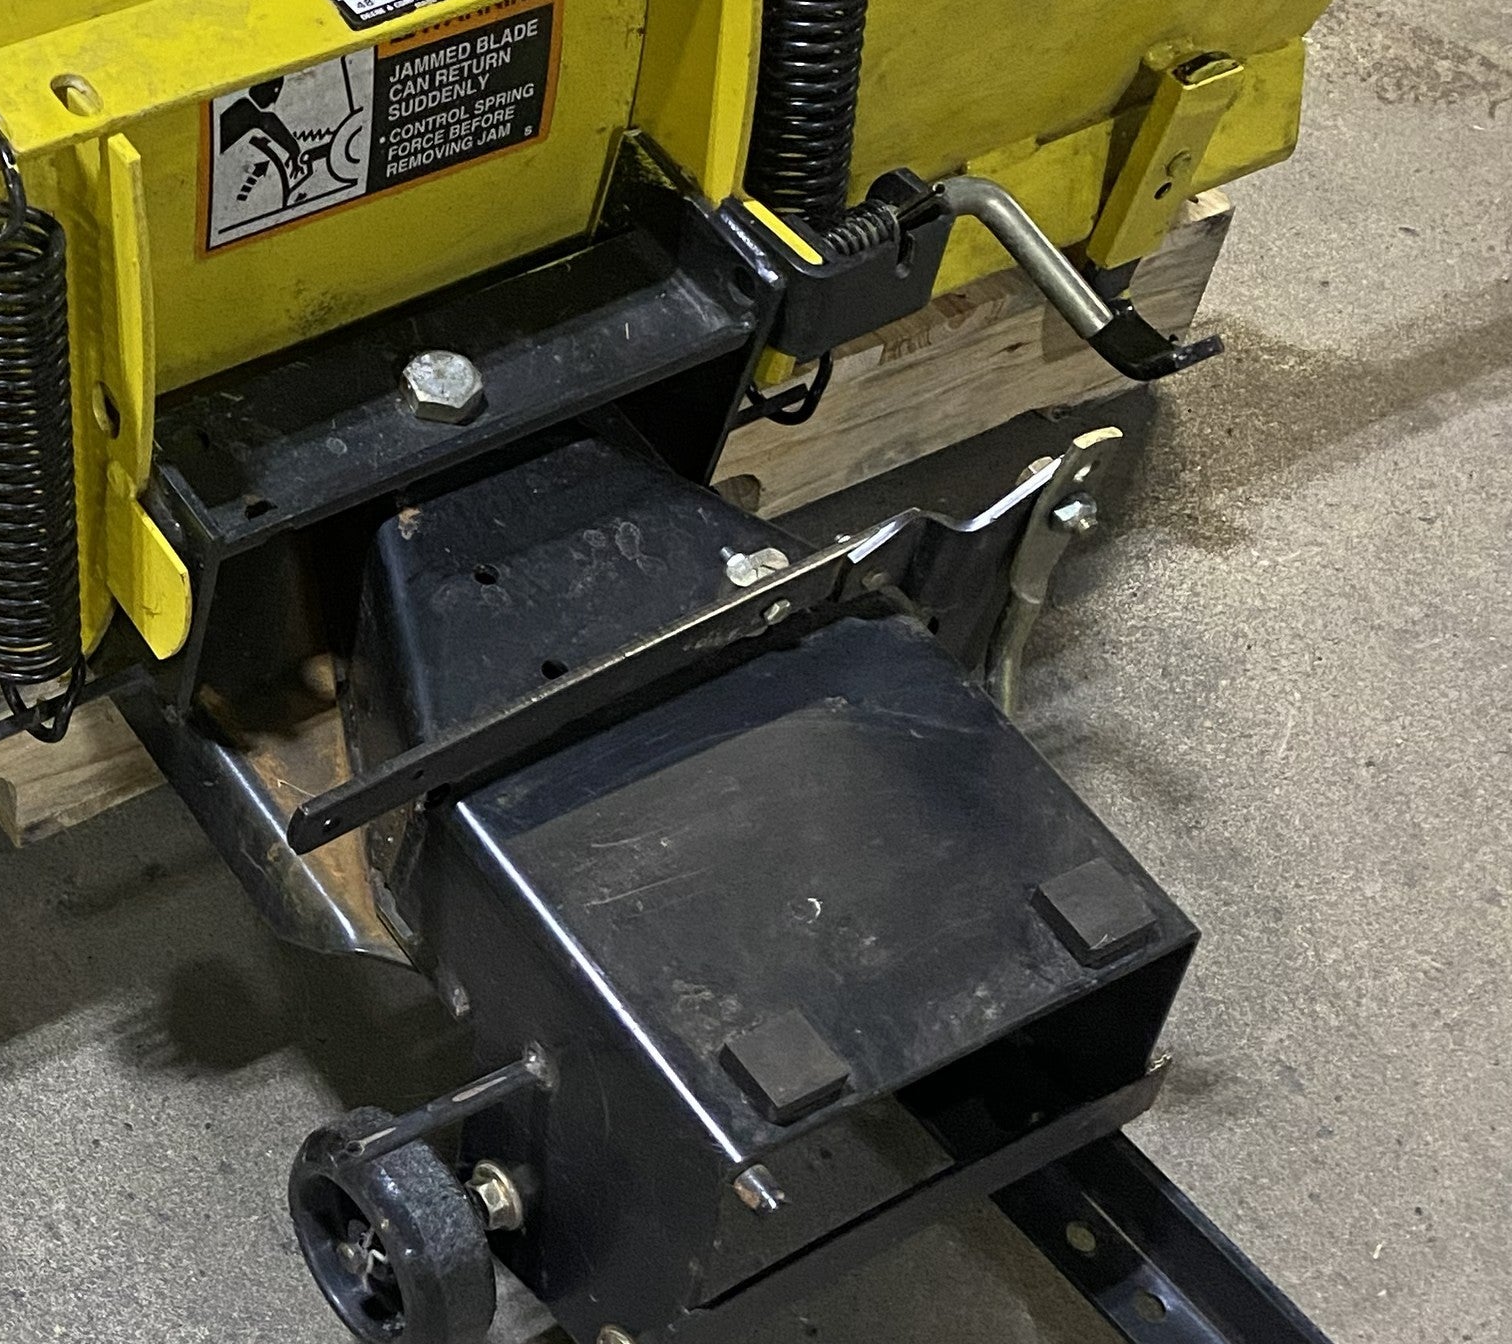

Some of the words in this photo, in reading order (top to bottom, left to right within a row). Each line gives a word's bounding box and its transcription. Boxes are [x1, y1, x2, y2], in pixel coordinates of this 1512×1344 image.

[389, 41, 471, 83] JAMMED
[476, 18, 538, 54] BLADE
[389, 74, 429, 102] CAN
[435, 47, 512, 86] RETURN
[388, 73, 490, 121] SUDDENLY
[389, 106, 470, 143] CONTROL
[474, 83, 535, 114] SPRING
[386, 135, 473, 178] REMOVING
[477, 122, 511, 146] JAM
[388, 129, 444, 161] FORCE
[449, 105, 516, 140] BEFORE
